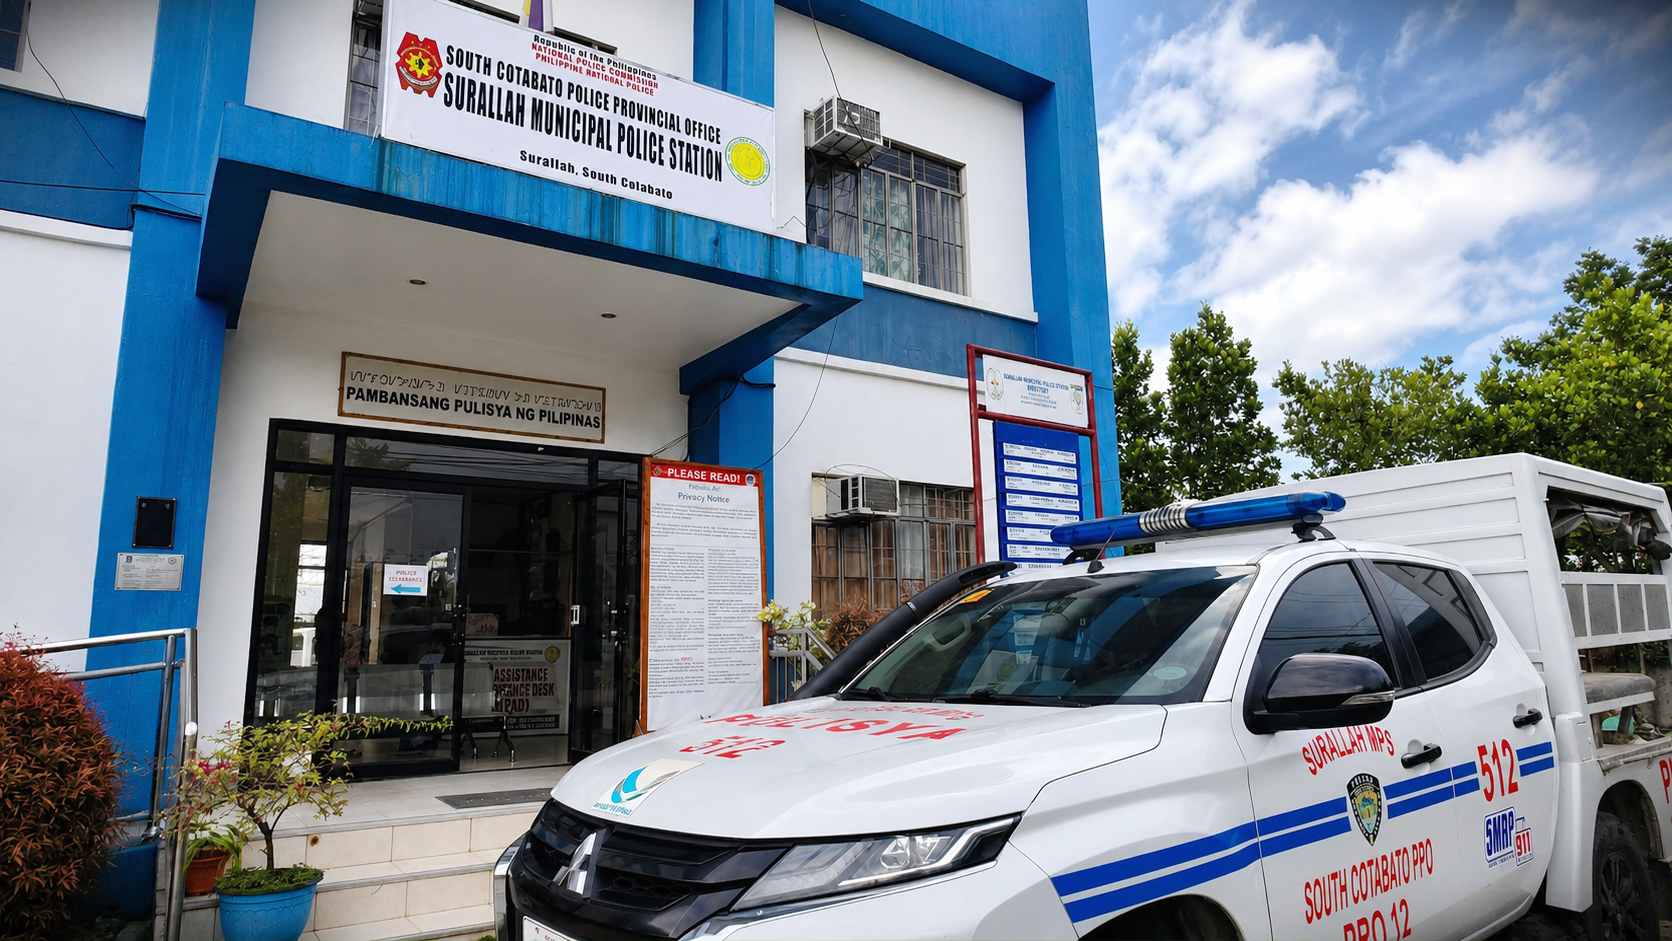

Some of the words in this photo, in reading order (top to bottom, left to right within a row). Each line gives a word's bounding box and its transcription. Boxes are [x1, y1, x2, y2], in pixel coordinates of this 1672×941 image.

[532, 43, 573, 63] NATIONAL
[576, 57, 606, 72] POLICE
[535, 53, 584, 75] PHILIPPINE
[586, 67, 624, 87] NATIONAL
[626, 81, 654, 96] POLICE
[446, 45, 492, 77] SOUTH
[497, 60, 563, 98] COTABATO
[567, 82, 609, 111] POLICE
[613, 96, 681, 134] PROVINCIAL
[684, 117, 721, 145] OFFICE
[443, 72, 525, 128] SURALLAH
[531, 97, 612, 152] MUNICIPAL
[617, 122, 665, 167] POLICE
[669, 137, 722, 182] STATION
[582, 167, 617, 185] South
[346, 386, 450, 411] PAMBANSANG
[454, 399, 512, 419] PULISYA
[516, 407, 535, 421] NG
[539, 409, 600, 428] PILIPINAS
[667, 468, 707, 480] PLEASE
[710, 471, 740, 483] READ!
[677, 492, 705, 503] Privacy
[707, 494, 730, 504] Notice
[493, 668, 548, 682] ASSISTANCE
[532, 683, 555, 697] DESK
[1302, 725, 1367, 775] SURALLAH
[1364, 724, 1394, 757] MPS
[1477, 738, 1519, 802] 512
[1515, 831, 1531, 856] 911
[1304, 868, 1349, 924] SOUTH
[1351, 847, 1410, 905] COTABATO
[1412, 838, 1433, 880] PPO
[1391, 899, 1412, 941] 12
